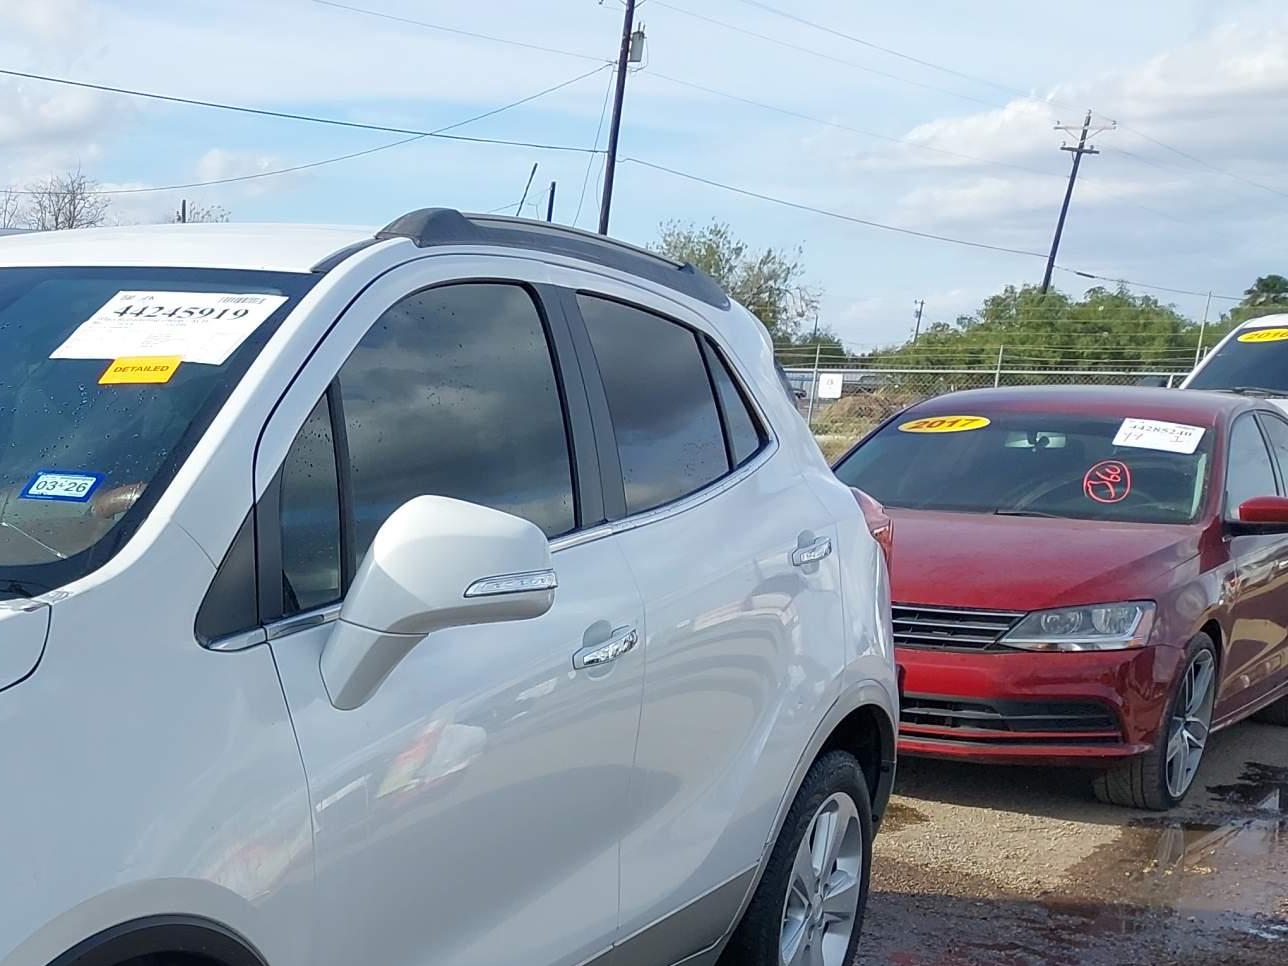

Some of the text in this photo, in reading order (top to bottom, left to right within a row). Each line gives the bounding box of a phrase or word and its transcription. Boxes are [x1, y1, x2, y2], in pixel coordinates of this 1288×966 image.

[113, 304, 249, 321] 44245919
[113, 365, 170, 373] DETAILED
[906, 418, 983, 430] 2017
